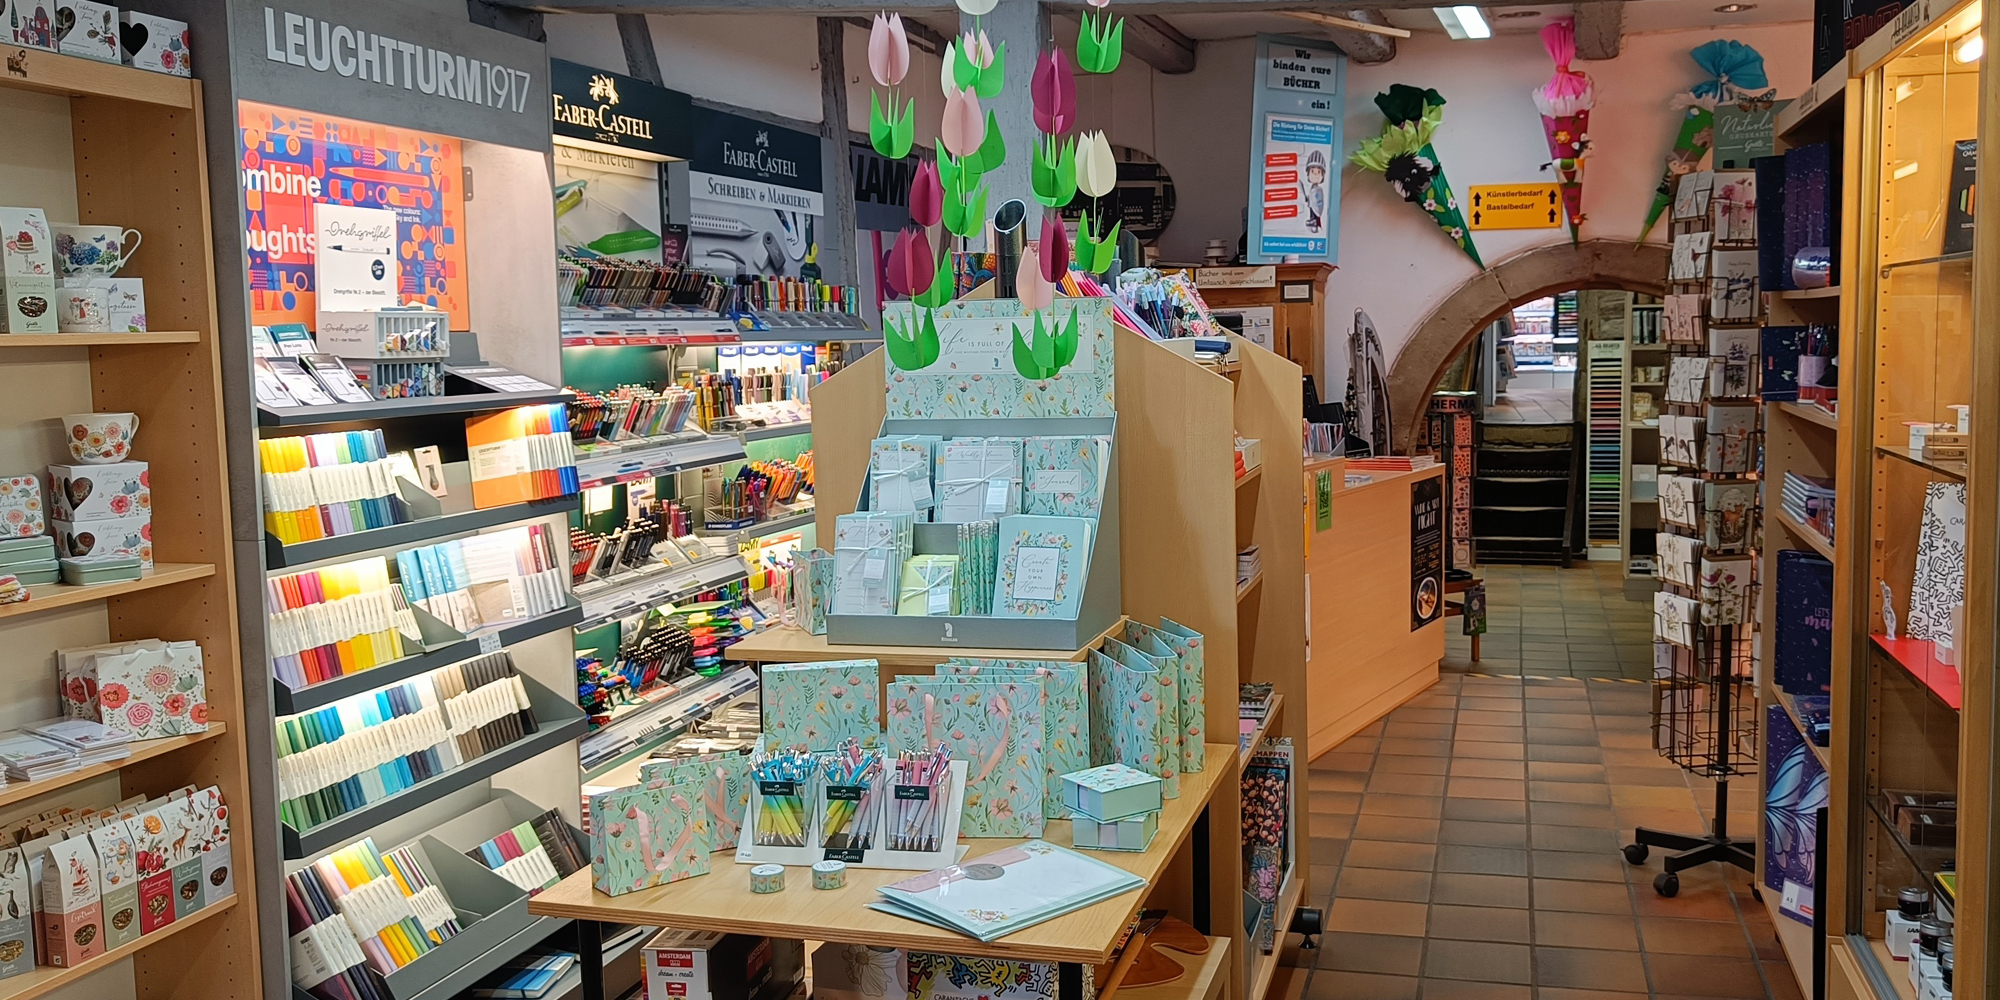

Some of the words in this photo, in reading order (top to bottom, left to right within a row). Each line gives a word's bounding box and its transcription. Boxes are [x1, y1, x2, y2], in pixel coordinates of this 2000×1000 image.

[264, 7, 531, 114] LEUCHTTURM1917
[1295, 49, 1311, 60] Wir
[1273, 59, 1306, 72] binden
[1311, 66, 1331, 75] eure
[1283, 75, 1320, 90] BÜCHER
[552, 93, 653, 140] FABER-CASTELL
[723, 141, 798, 178] FABER-CASTELL
[855, 154, 909, 207] LAM
[707, 176, 756, 200] SCHREIBEN
[759, 193, 766, 201] &
[767, 187, 812, 210] MARKIEREN
[1486, 189, 1543, 198] Künstlerbedarf
[1486, 202, 1535, 211] Bastelbedarf
[1431, 399, 1476, 410] HERMA
[658, 952, 692, 960] AMSTERDAM
